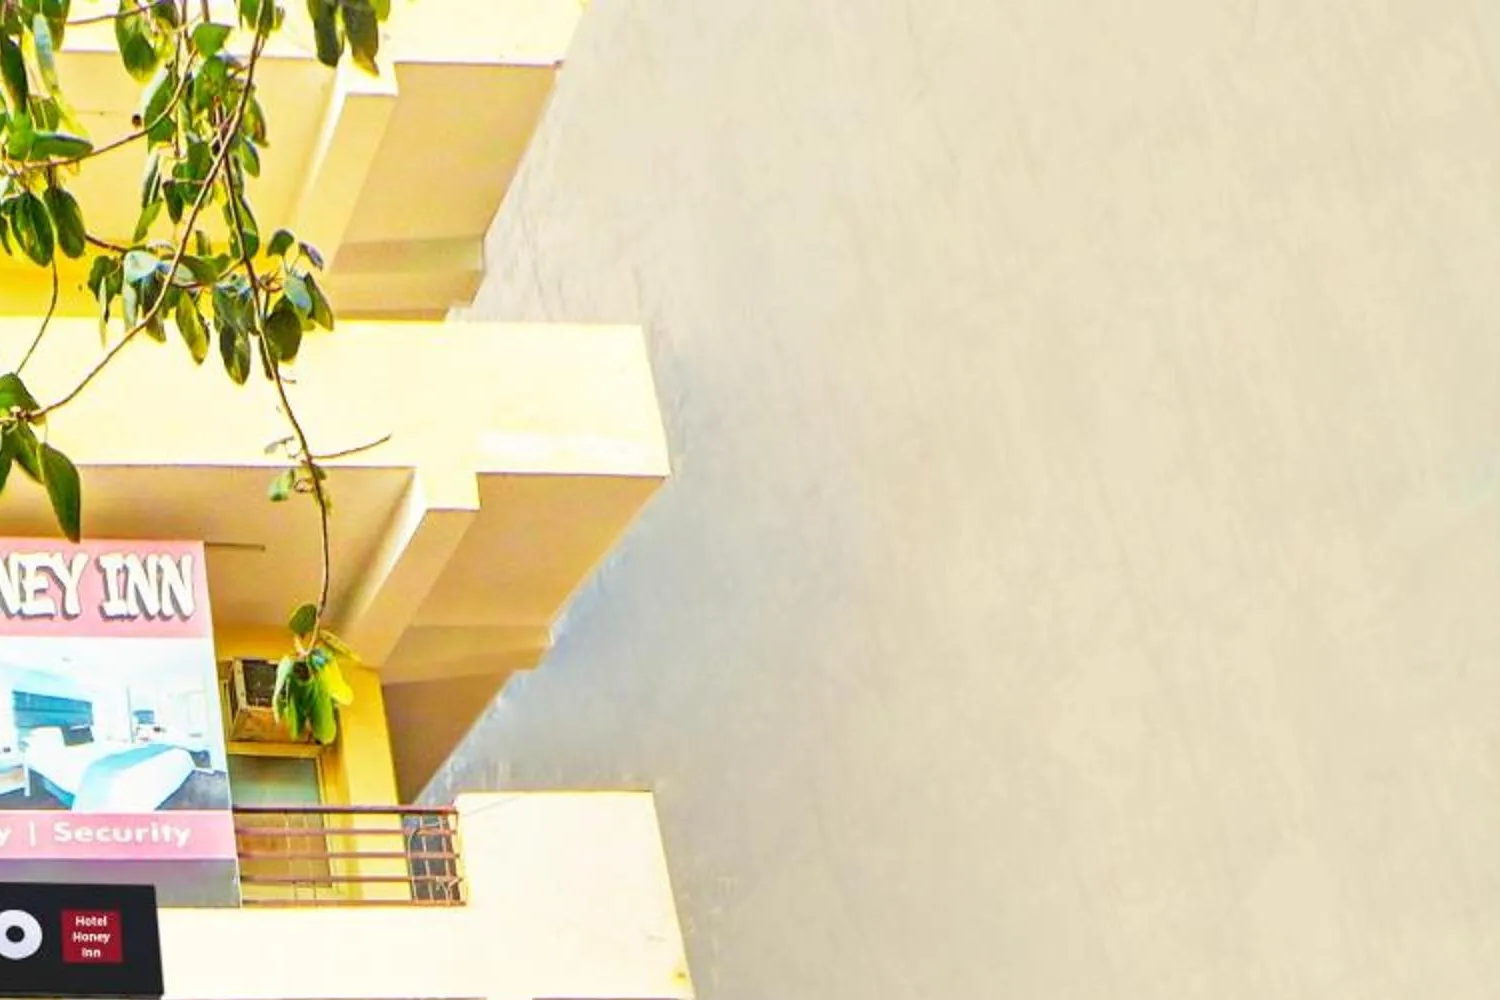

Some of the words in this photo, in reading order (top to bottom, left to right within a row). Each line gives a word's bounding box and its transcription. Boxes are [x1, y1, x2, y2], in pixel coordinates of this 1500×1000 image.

[96, 552, 197, 621] INN
[53, 821, 192, 847] Security
[75, 915, 108, 927] Hotel
[72, 931, 111, 945] Honey
[81, 947, 102, 959] Inn
